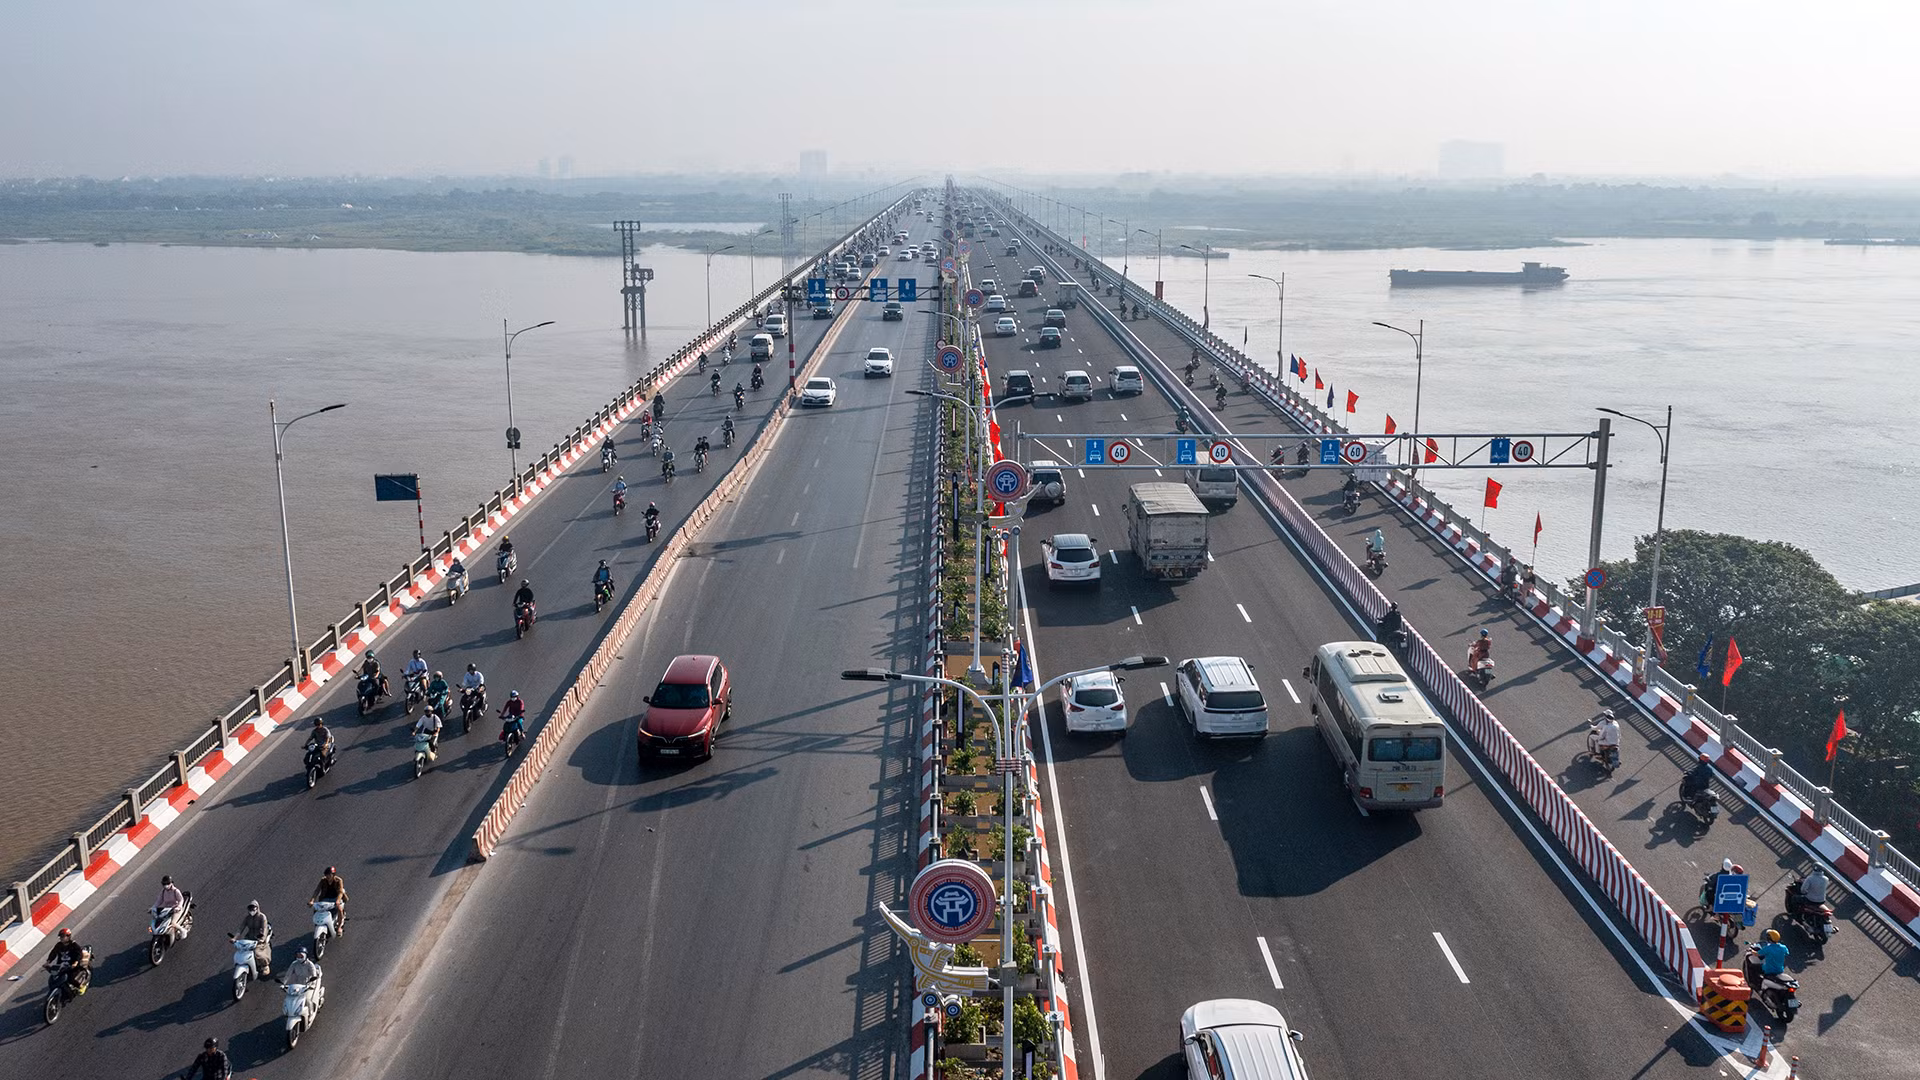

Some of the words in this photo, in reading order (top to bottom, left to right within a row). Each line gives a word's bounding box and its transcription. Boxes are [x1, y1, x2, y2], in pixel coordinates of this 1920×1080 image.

[1114, 447, 1125, 458] 60
[1215, 447, 1226, 458] 60
[1350, 447, 1361, 457] 60
[1517, 446, 1528, 456] 40
